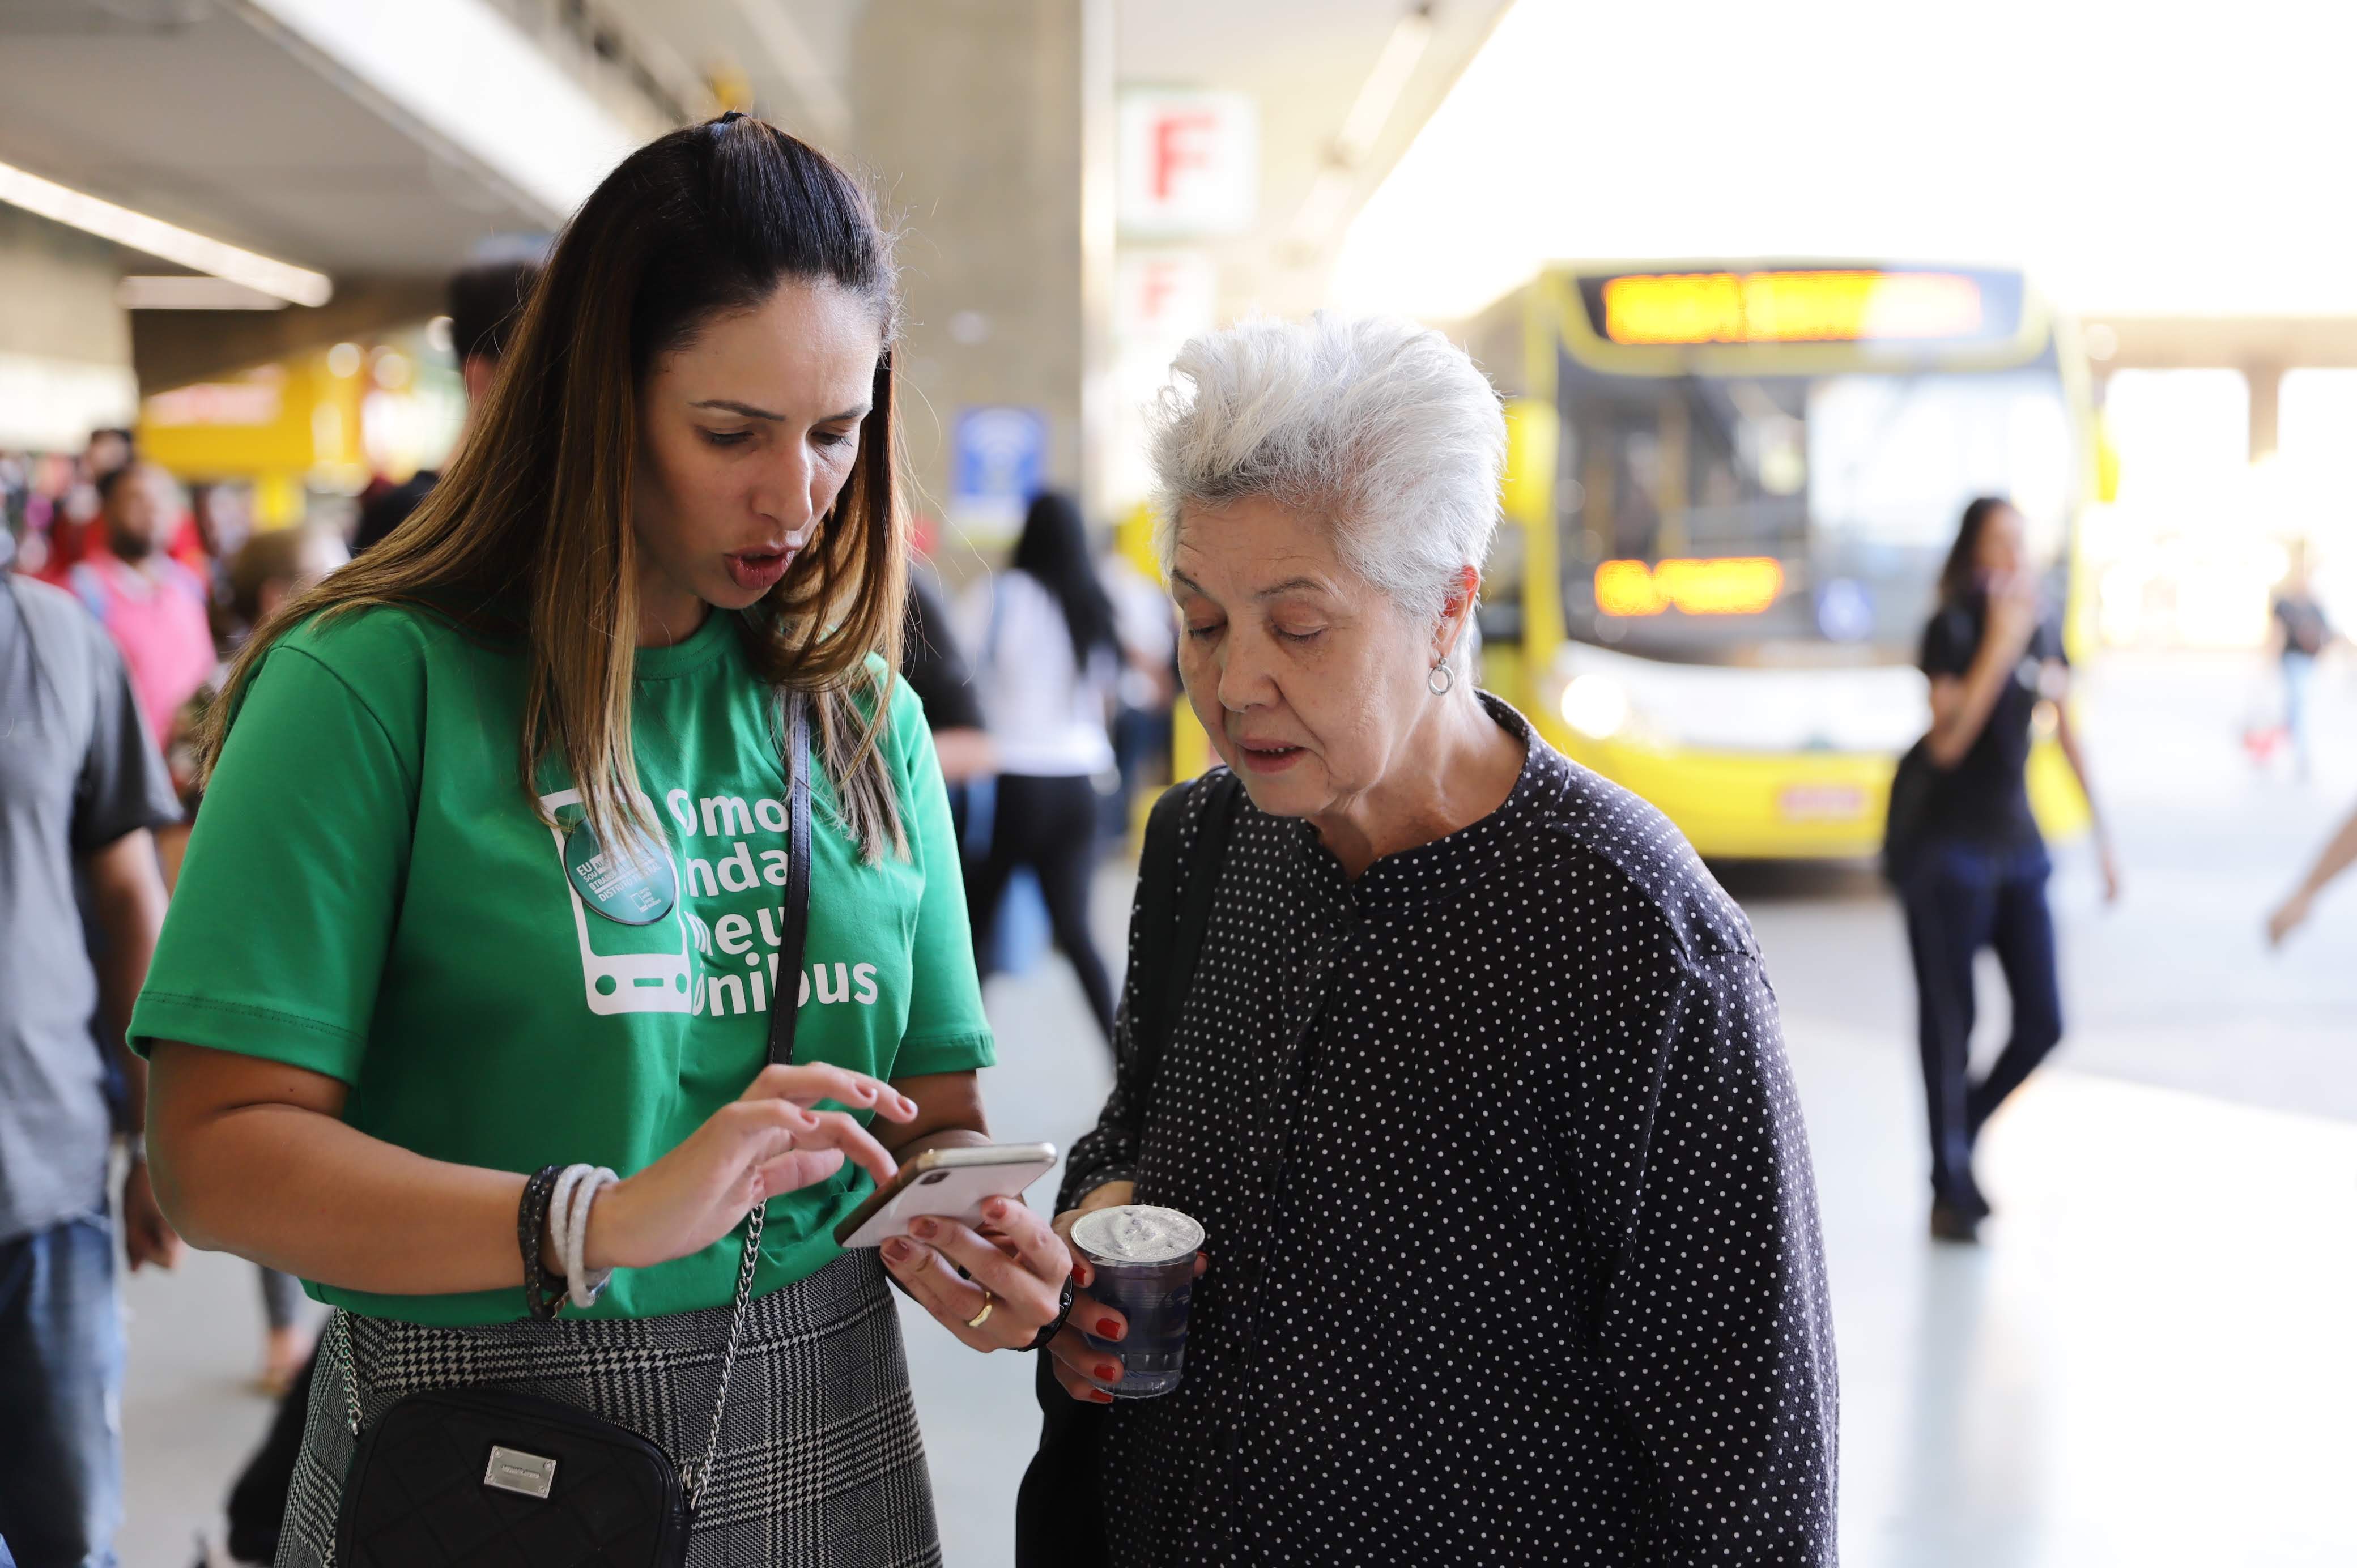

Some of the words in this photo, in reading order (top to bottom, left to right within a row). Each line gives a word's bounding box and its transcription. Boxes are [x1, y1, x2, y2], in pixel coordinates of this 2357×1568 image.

[1148, 109, 1218, 203] F
[576, 862, 592, 876] EU
[583, 872, 598, 883] SOU
[684, 842, 788, 897] nda
